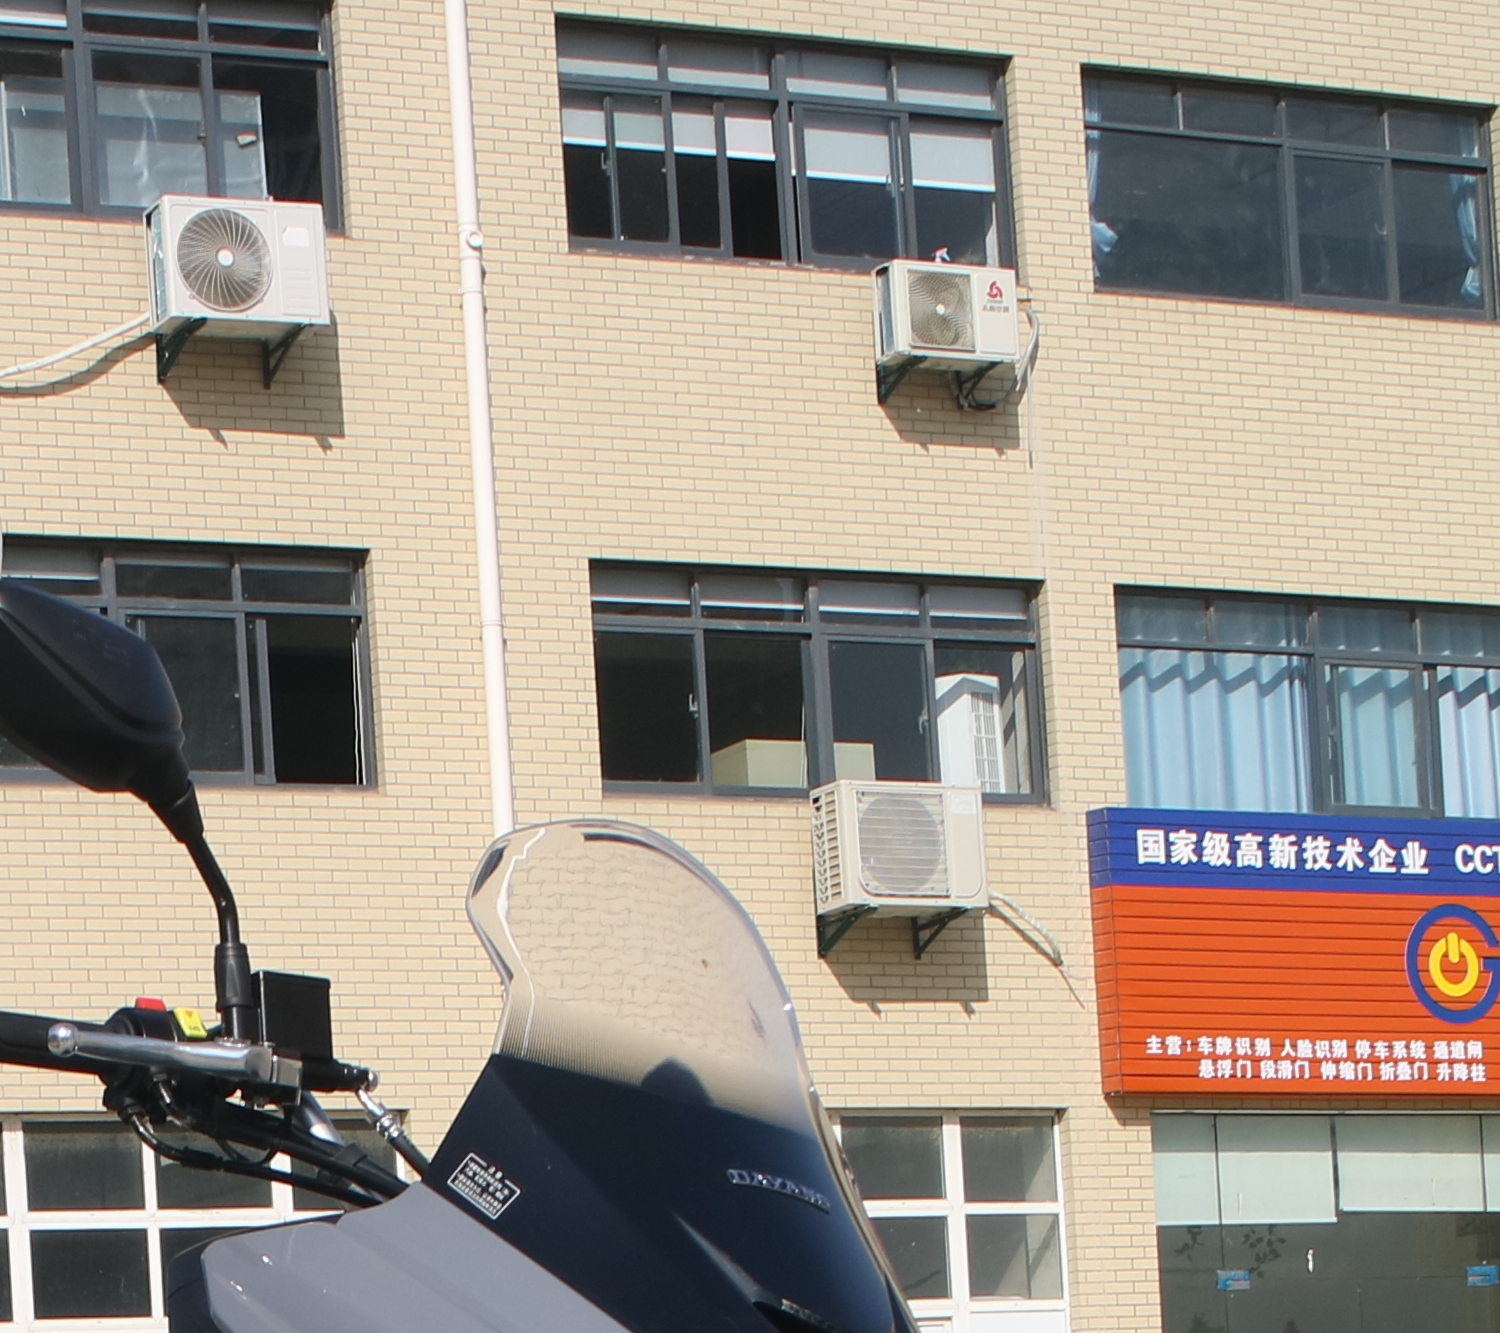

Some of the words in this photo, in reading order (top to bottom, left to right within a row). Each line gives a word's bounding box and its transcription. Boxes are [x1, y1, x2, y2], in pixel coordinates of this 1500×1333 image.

[1136, 828, 1429, 874] 国家级高新技术企业
[1280, 1038, 1348, 1058] 人脸识别
[1355, 1039, 1427, 1059] 停车系统
[1198, 1059, 1252, 1079] 悬浮门
[1320, 1061, 1373, 1080] 伸缩门
[1437, 1063, 1487, 1082] 升降柱
